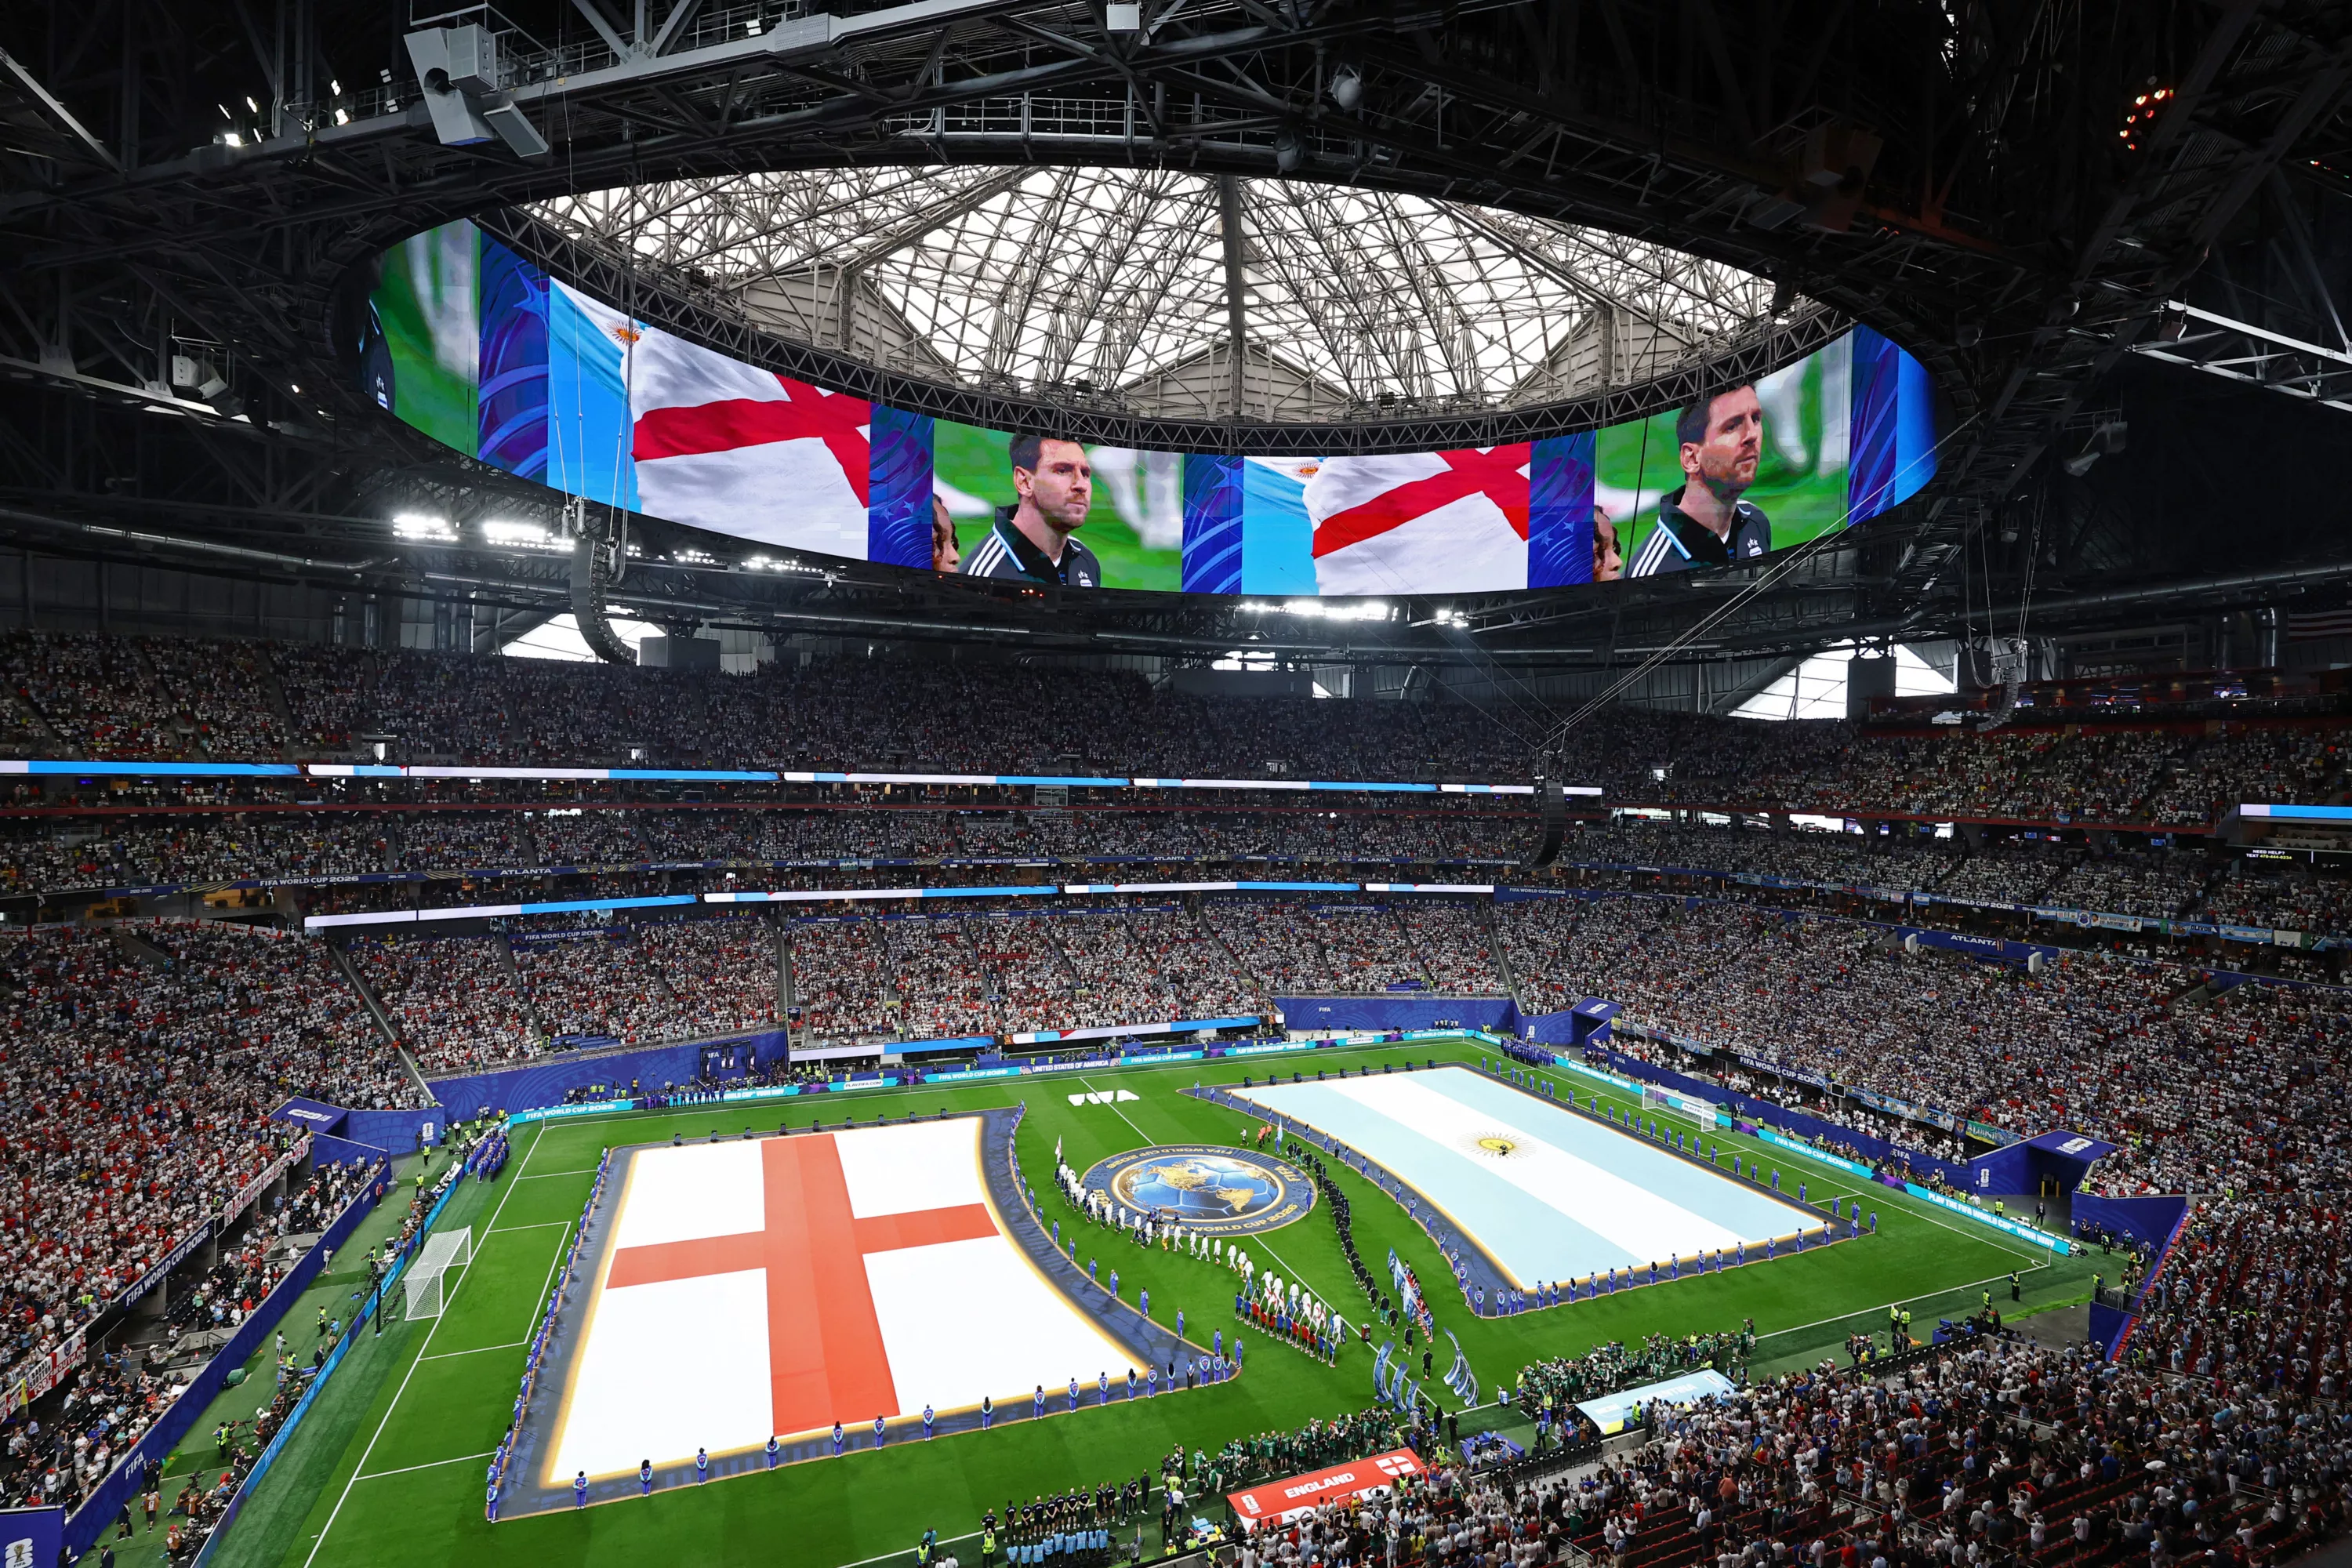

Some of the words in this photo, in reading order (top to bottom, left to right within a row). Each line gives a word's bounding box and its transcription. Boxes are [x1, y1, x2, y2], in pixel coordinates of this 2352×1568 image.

[281, 877, 310, 885] WORLD
[1951, 897, 1975, 906] WORLD
[1033, 1064, 1054, 1073] UNITED
[1083, 1060, 1109, 1069] AMERICA
[1739, 1057, 1755, 1068] FIFA
[1755, 1060, 1780, 1074] WORLD
[1781, 1066, 1797, 1079] CUP
[1797, 1073, 1820, 1085] 202
[544, 1109, 571, 1118] WORLD
[1774, 1136, 1788, 1148] FIFA
[1789, 1140, 1813, 1154] WORLD
[1813, 1148, 1827, 1159] CUP
[1243, 1220, 1267, 1229] CUP
[1267, 1203, 1298, 1222] 2026
[1929, 1192, 1945, 1206] PLAY
[1946, 1200, 1957, 1210] THE
[1958, 1204, 1973, 1216] FIFA
[1973, 1209, 1998, 1226] WORLD
[2016, 1223, 2037, 1241] YOUR
[2037, 1231, 2056, 1248] WAY
[126, 1284, 144, 1307] FIFA
[144, 1260, 171, 1290] WORLD
[171, 1248, 186, 1266] CUP
[185, 1226, 209, 1254] 2026
[125, 1450, 144, 1480] FIFA
[1284, 1472, 1356, 1499] ENGLAND
